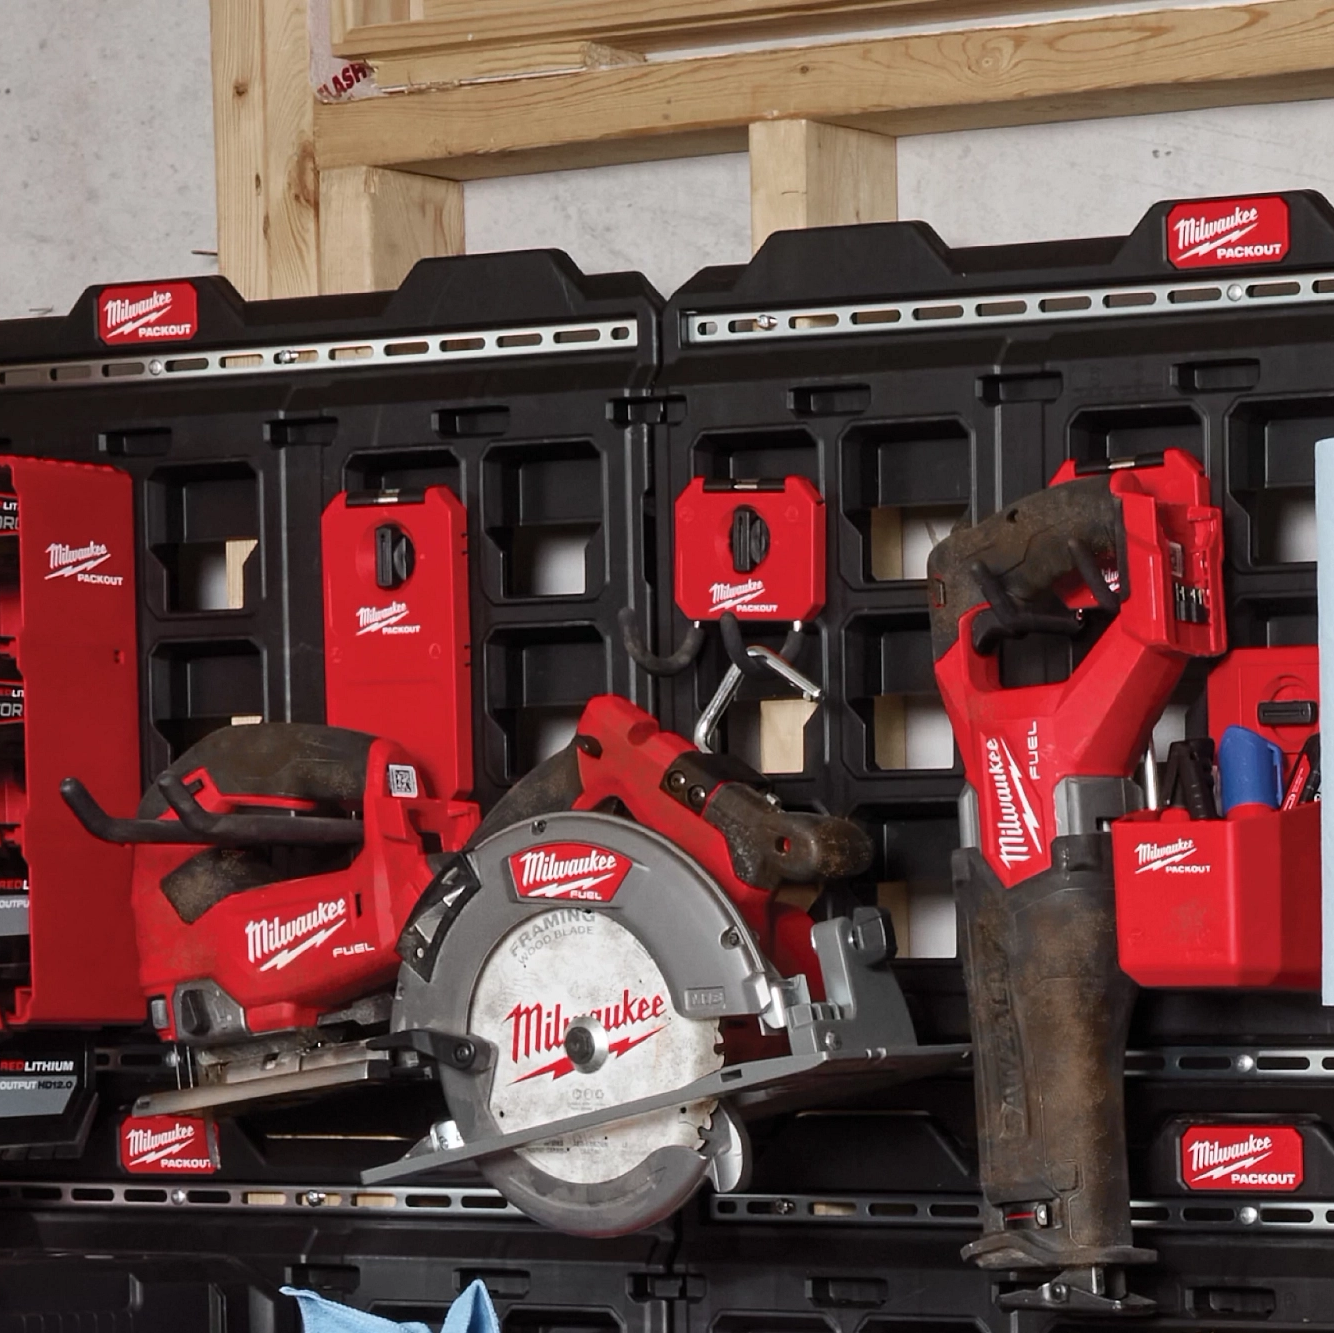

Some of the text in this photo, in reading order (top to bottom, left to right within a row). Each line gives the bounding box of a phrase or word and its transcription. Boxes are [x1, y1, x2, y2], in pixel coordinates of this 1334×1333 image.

[1173, 206, 1258, 250] Milwaukee
[1216, 243, 1282, 259] PACKOUT
[103, 290, 172, 328] Milwaukee
[138, 323, 191, 338] PACKOUT
[45, 540, 108, 569] Milwaukee
[77, 573, 124, 586] PACKOUT
[736, 603, 779, 613] PACKOUT
[1027, 720, 1041, 781] FUEL
[986, 737, 1033, 870] Milwaukee
[1134, 838, 1195, 866] Milwaukee
[519, 849, 617, 888] Milwaukee
[1165, 864, 1212, 874] PACKOUT
[569, 889, 602, 900] FUEL
[245, 898, 347, 963] Milwaukee
[510, 906, 596, 958] FRAMING
[554, 925, 595, 940] BLADE
[332, 942, 376, 958] FUEL
[502, 989, 667, 1064] Milaukee
[0, 1059, 75, 1072] REDLITHIUM
[0, 1080, 37, 1090] OUTPUT
[37, 1080, 73, 1090] HD12.0
[125, 1123, 195, 1157] Milwaukee
[1187, 1133, 1273, 1172] Milwaukee
[1230, 1173, 1296, 1185] PACKOUT
